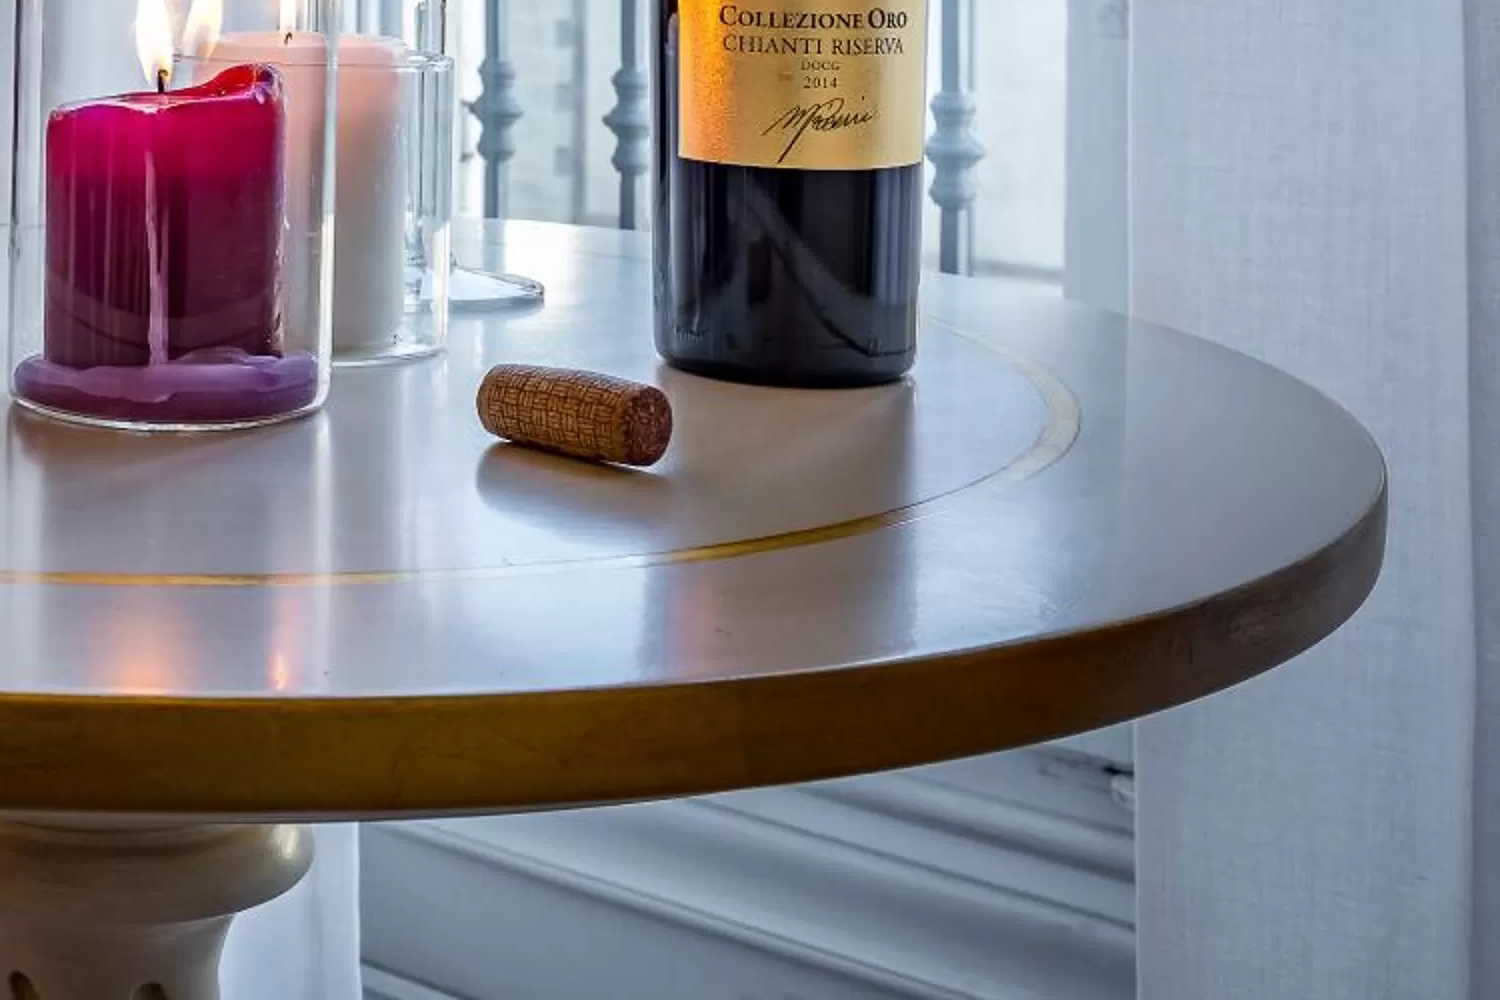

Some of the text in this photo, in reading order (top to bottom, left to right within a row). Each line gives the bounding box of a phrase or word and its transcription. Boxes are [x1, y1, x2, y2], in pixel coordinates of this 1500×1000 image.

[719, 5, 908, 29] COLLEZIONE ORO
[723, 34, 904, 55] CHIANTI RISERVA
[801, 60, 841, 71] DOCG
[803, 76, 838, 89] 2014
